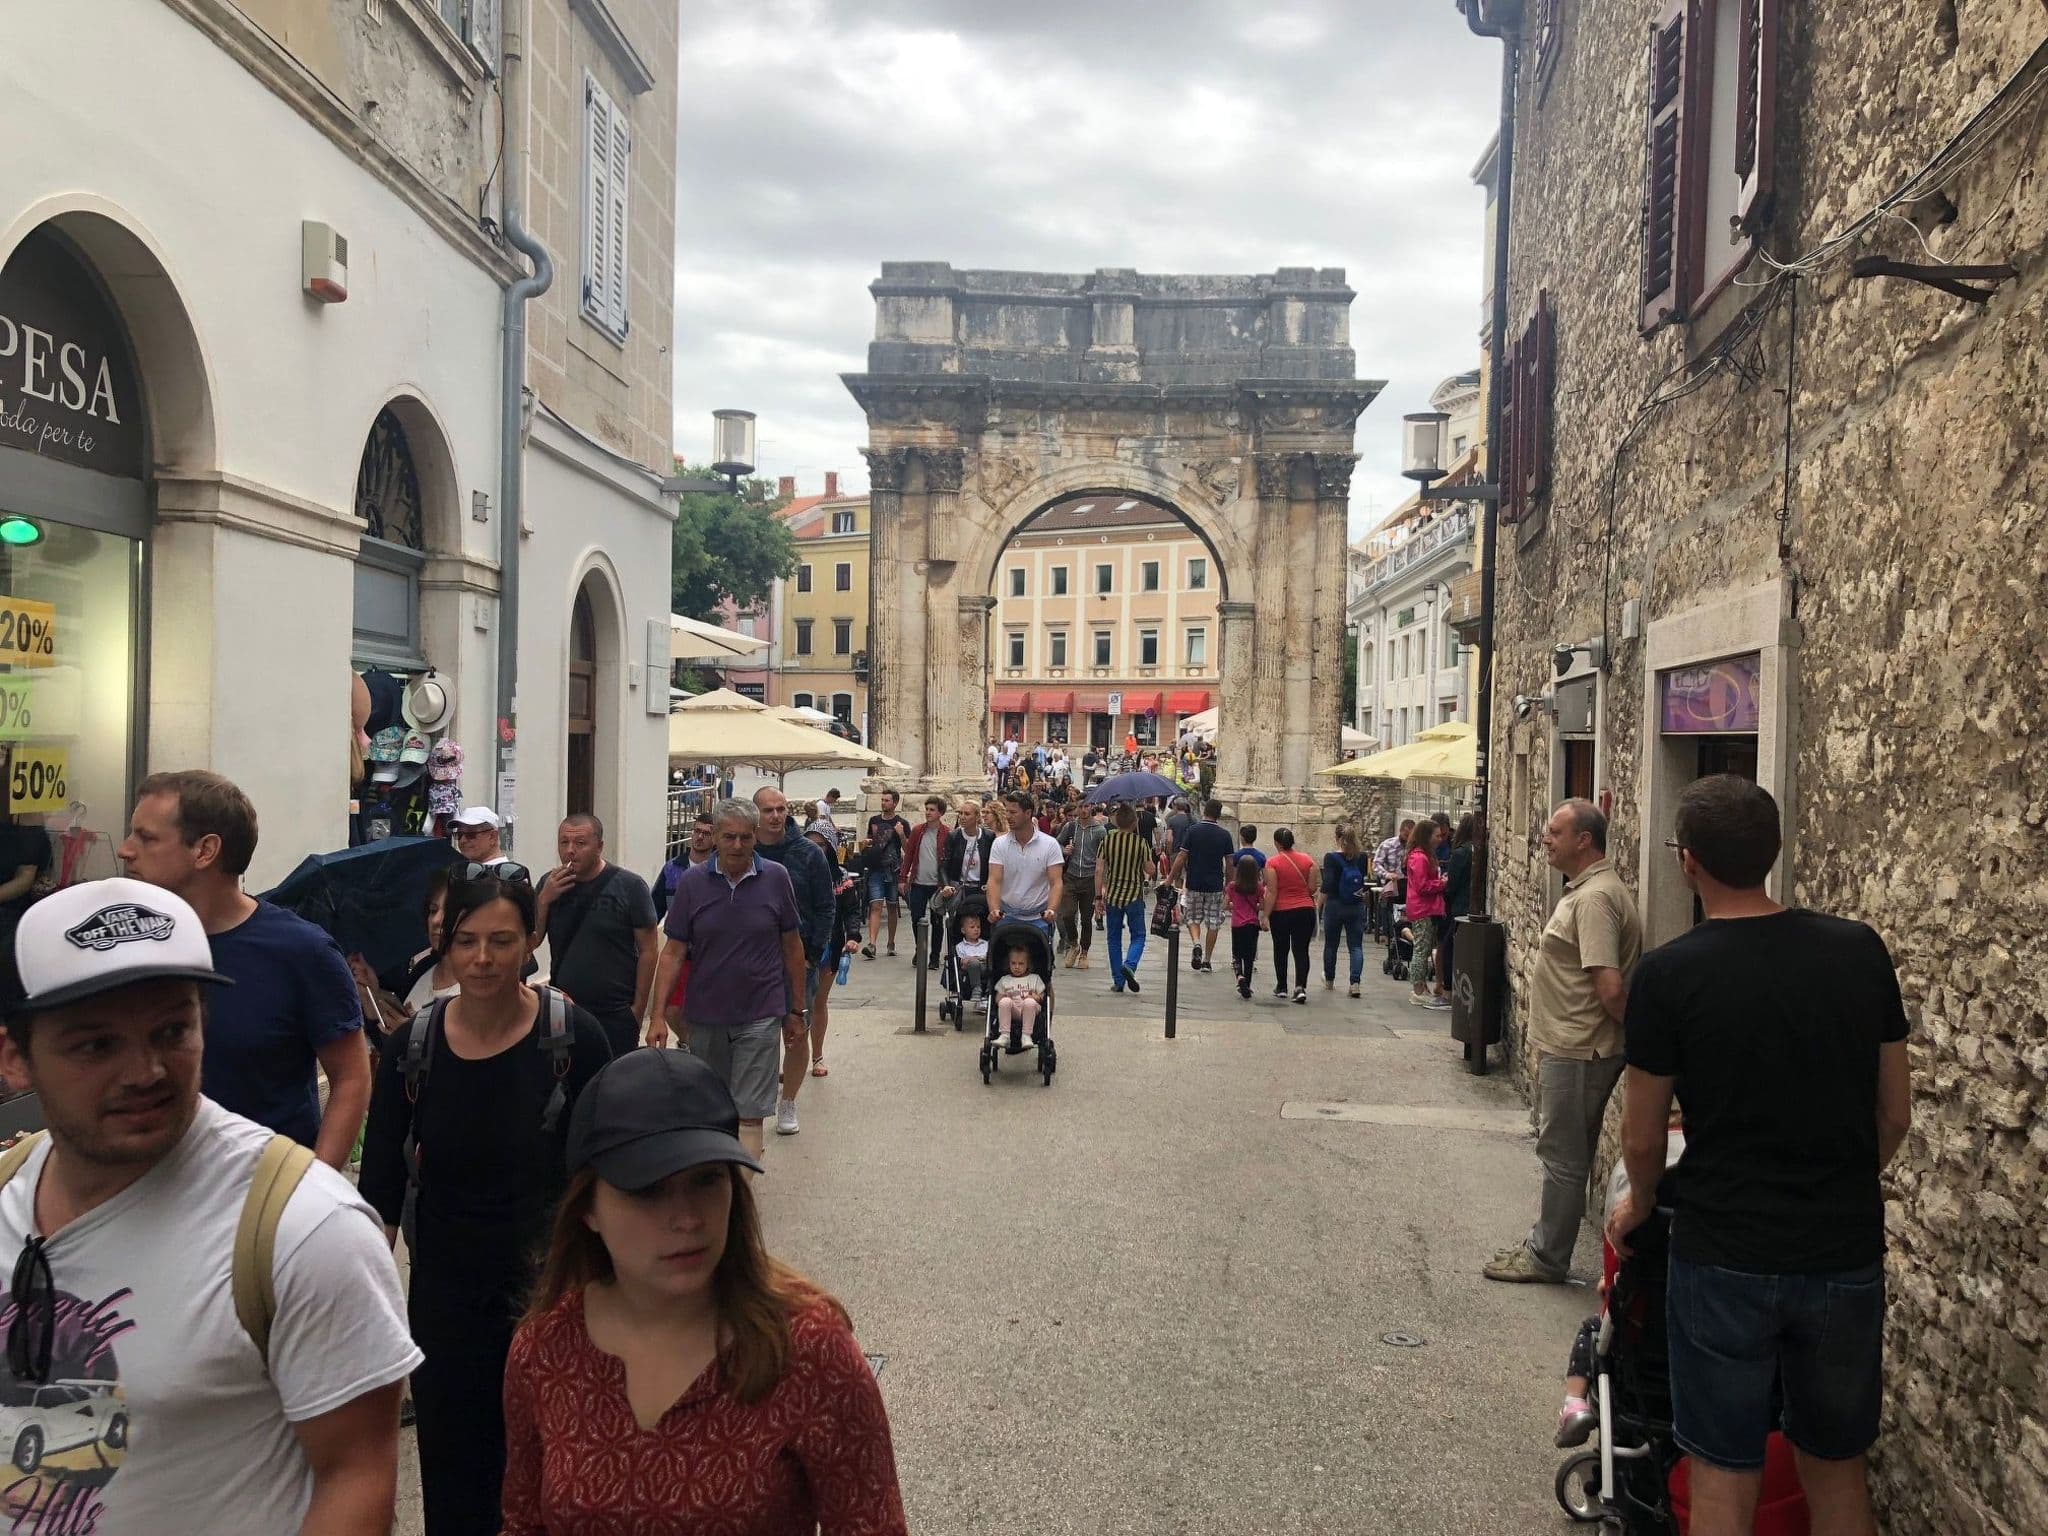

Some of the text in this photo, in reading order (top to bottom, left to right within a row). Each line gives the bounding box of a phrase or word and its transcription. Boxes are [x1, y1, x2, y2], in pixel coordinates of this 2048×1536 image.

[38, 422, 75, 452] per
[77, 430, 96, 452] te
[12, 761, 66, 800] 50%
[98, 907, 138, 925] VANS
[107, 919, 139, 937] THE
